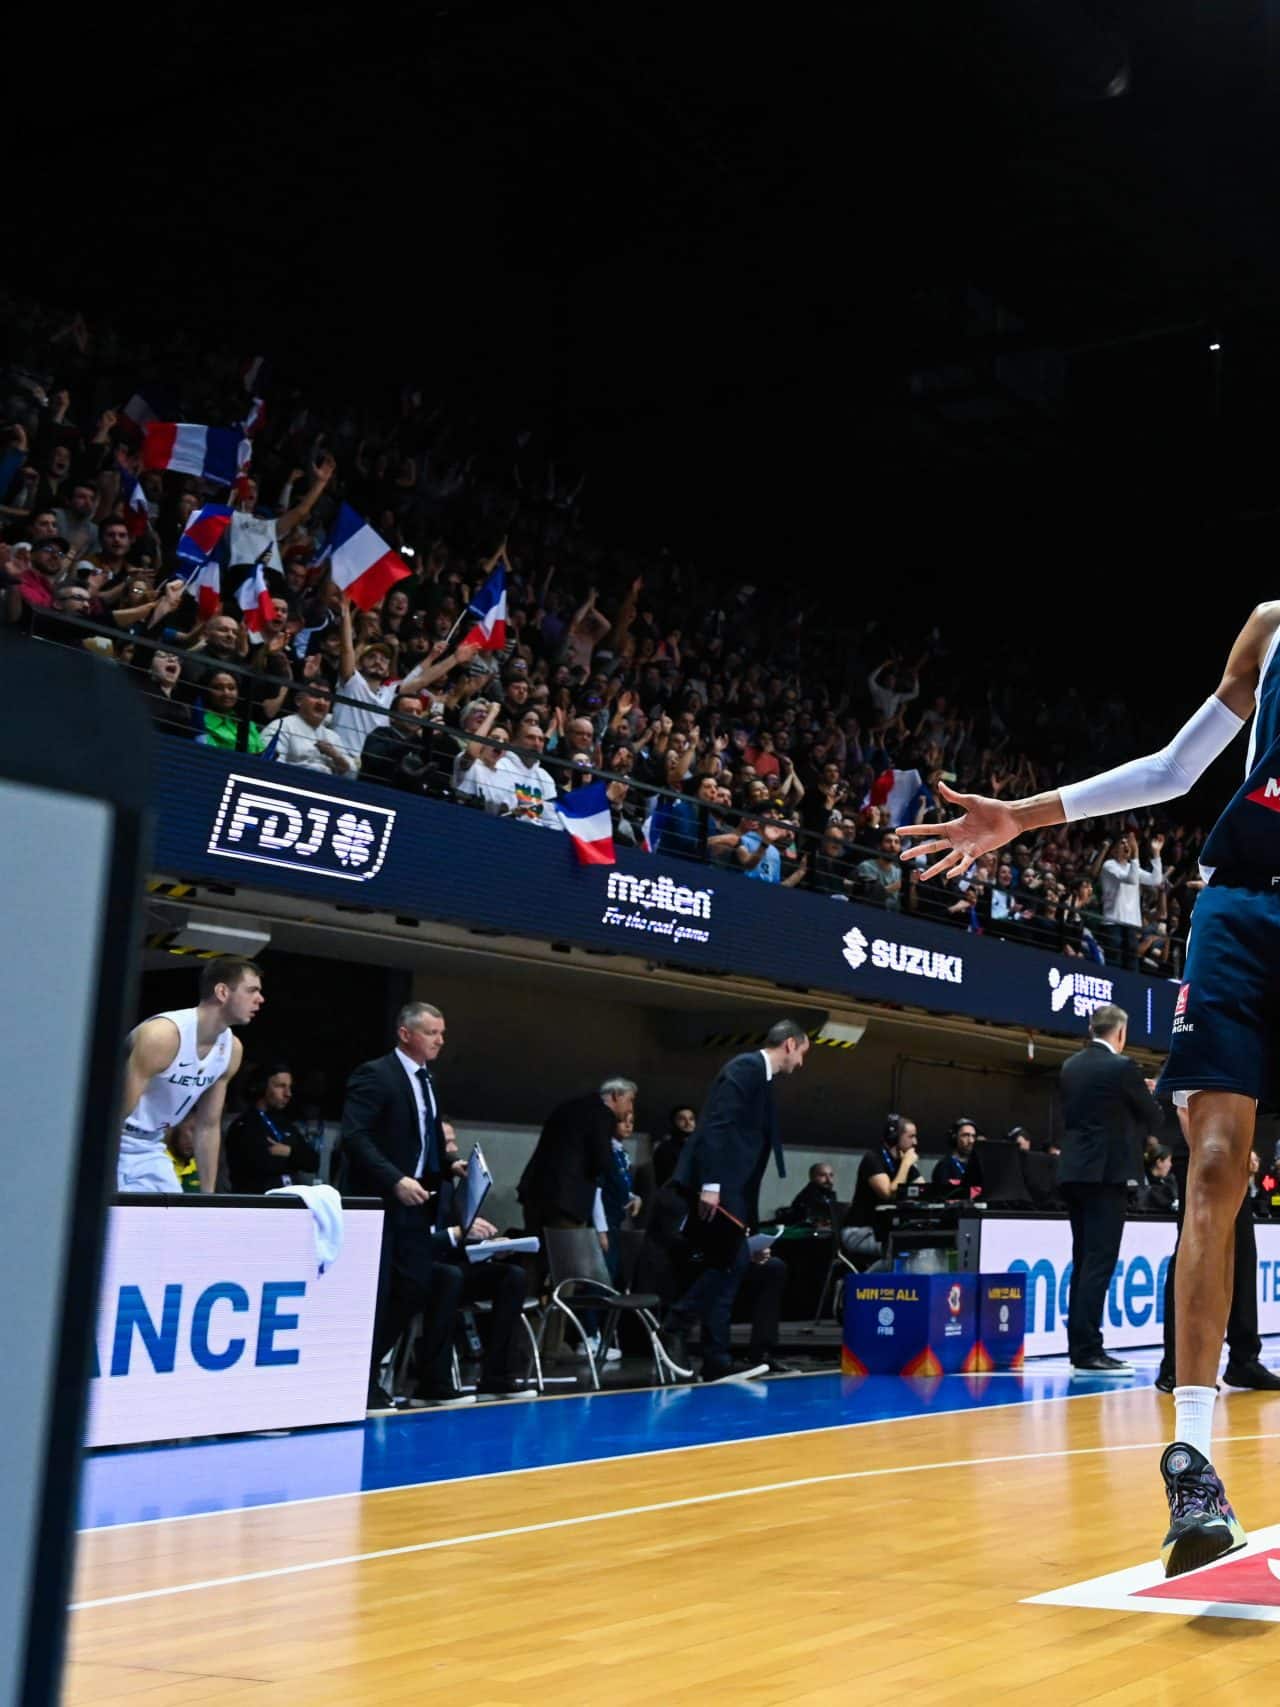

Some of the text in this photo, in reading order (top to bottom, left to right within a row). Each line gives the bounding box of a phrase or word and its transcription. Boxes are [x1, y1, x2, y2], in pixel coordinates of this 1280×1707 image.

[227, 792, 330, 856] FDJ
[608, 872, 712, 919] molten
[625, 911, 647, 930] the
[871, 939, 963, 983] SUZUKI
[1075, 973, 1113, 1000] INTER
[856, 1288, 879, 1300] WIN
[896, 1288, 919, 1301] ALL
[90, 1281, 306, 1379] NCE
